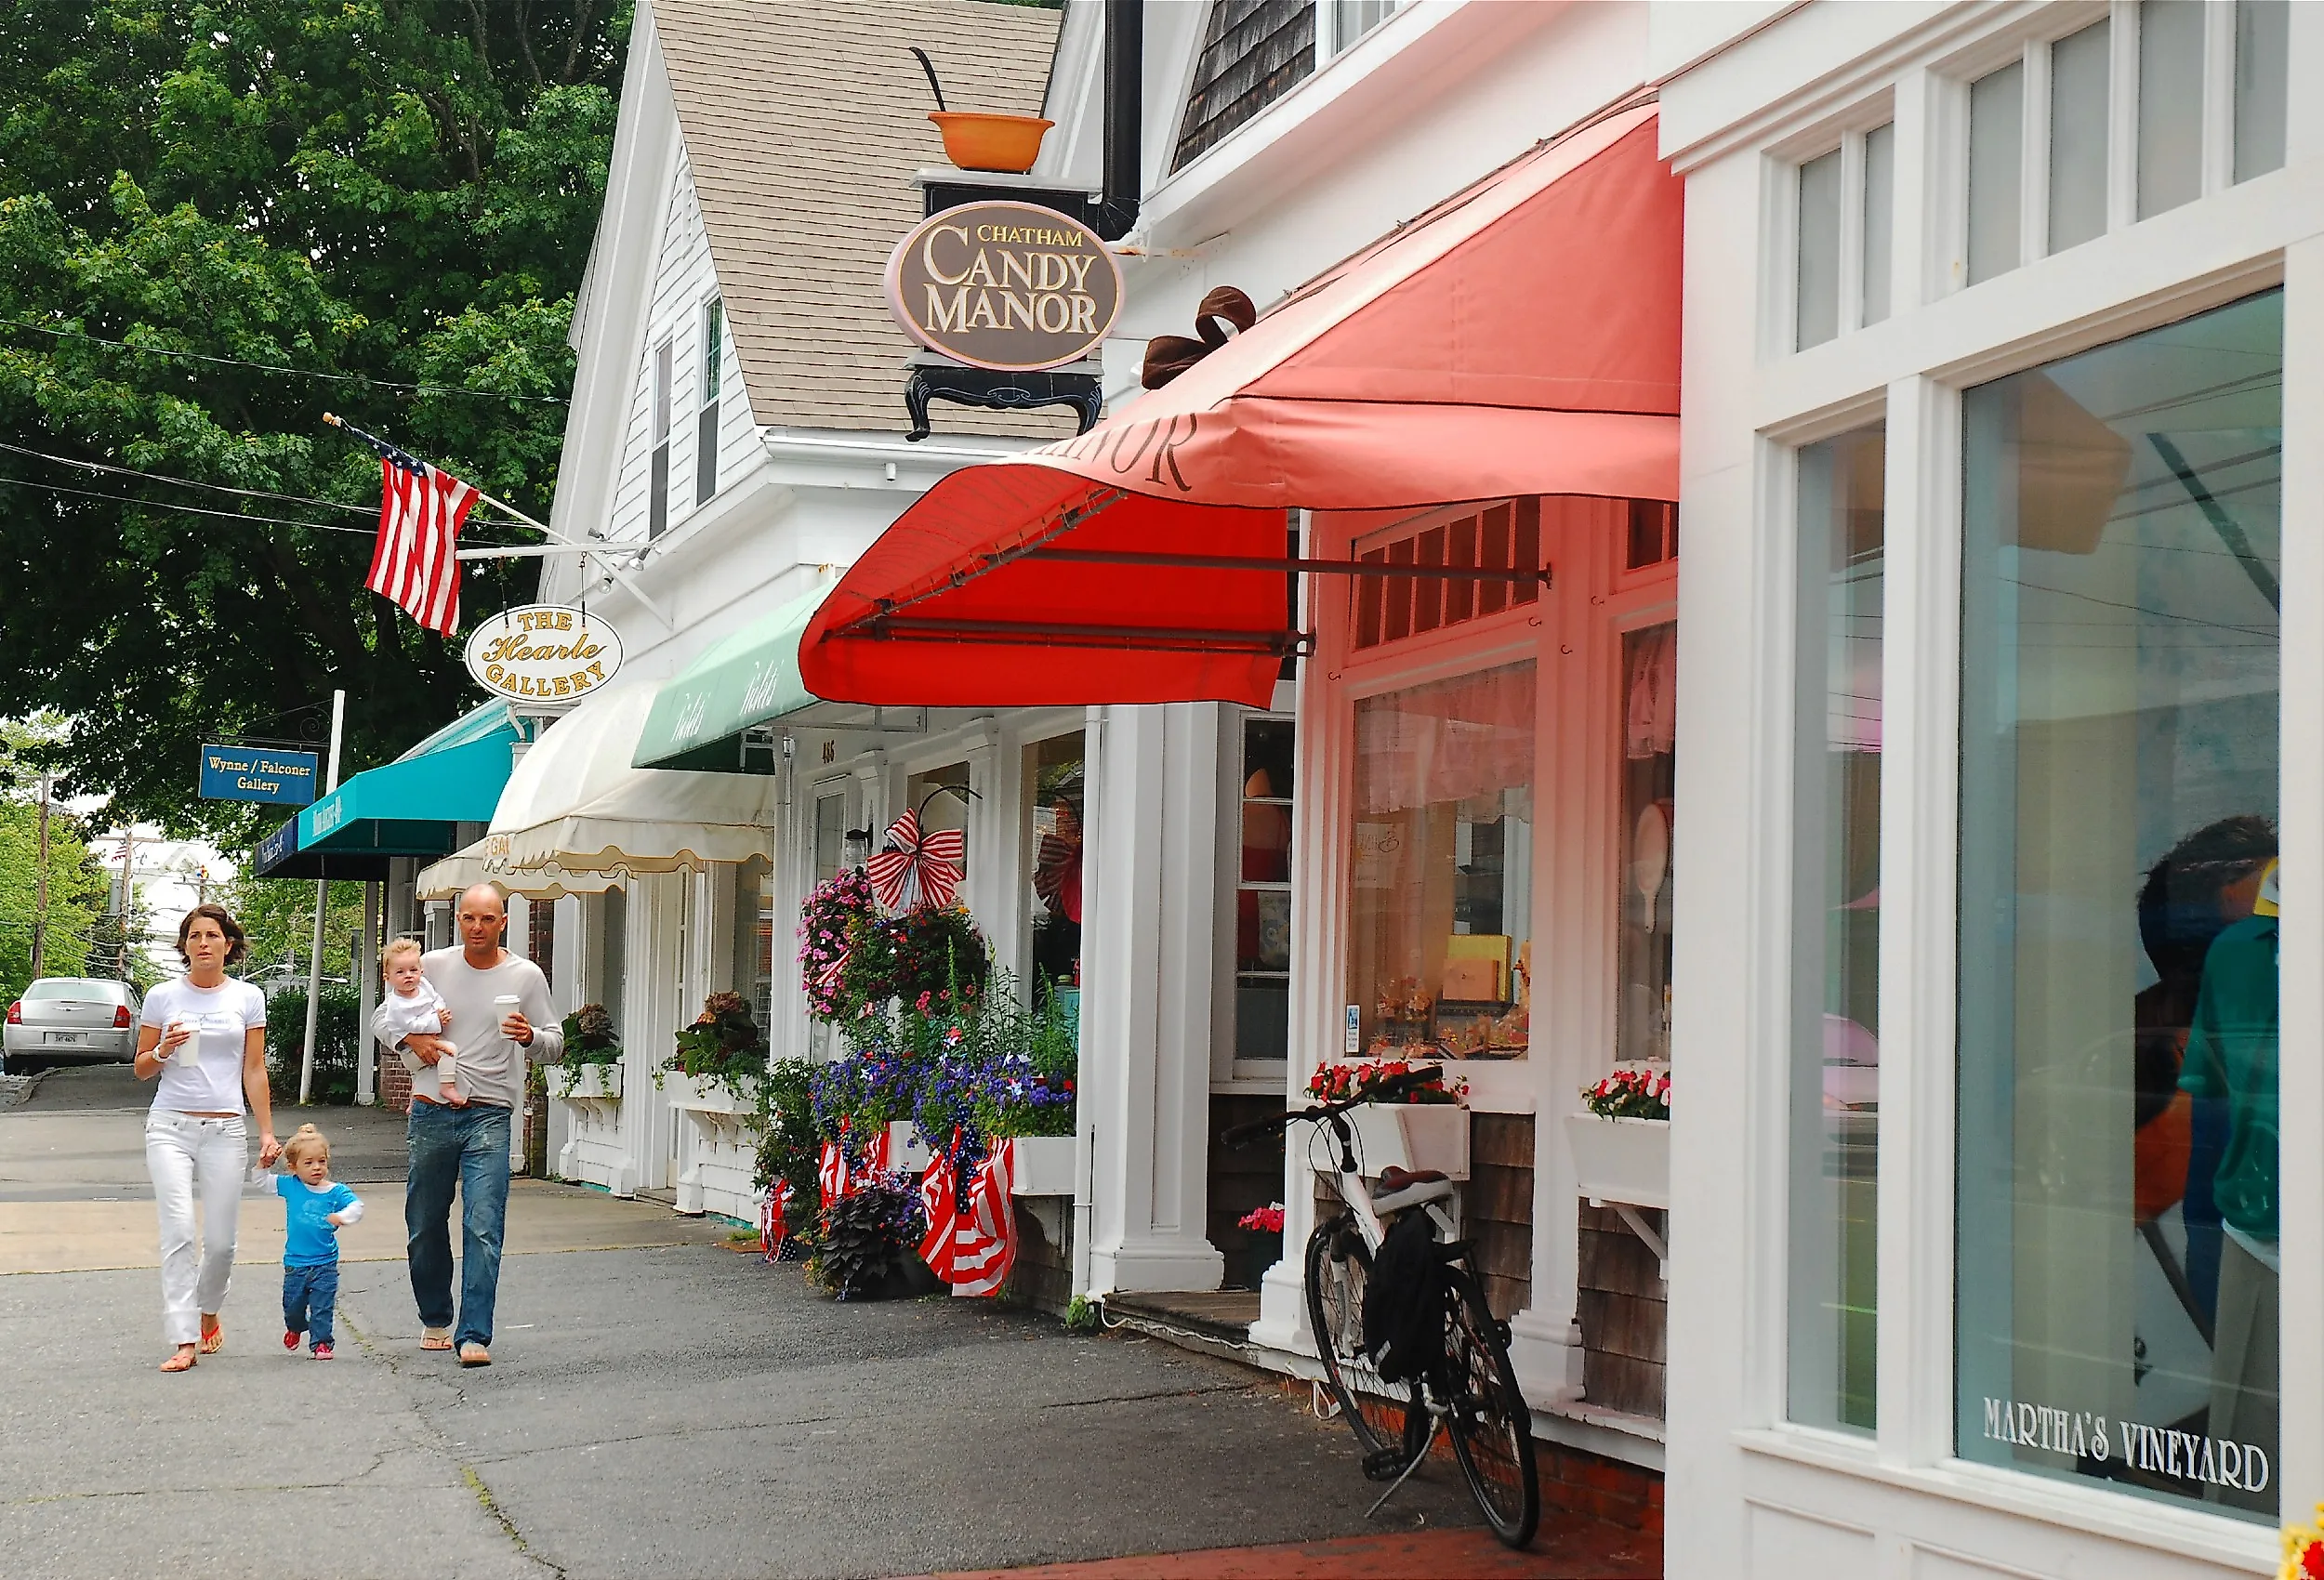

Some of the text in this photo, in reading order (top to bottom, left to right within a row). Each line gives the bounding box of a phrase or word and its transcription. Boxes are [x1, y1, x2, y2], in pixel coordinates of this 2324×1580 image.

[977, 224, 1083, 246] CHATHAM
[923, 224, 1097, 293] CANDY
[923, 283, 1098, 334] MANOR
[518, 612, 573, 632] THE
[482, 633, 607, 662] Hearle
[485, 661, 605, 696] GALLERY
[208, 757, 311, 776] Wynne / Falconer
[237, 776, 280, 795] Gallery
[1983, 1396, 2270, 1494] MARTHA'S VINEYARD
